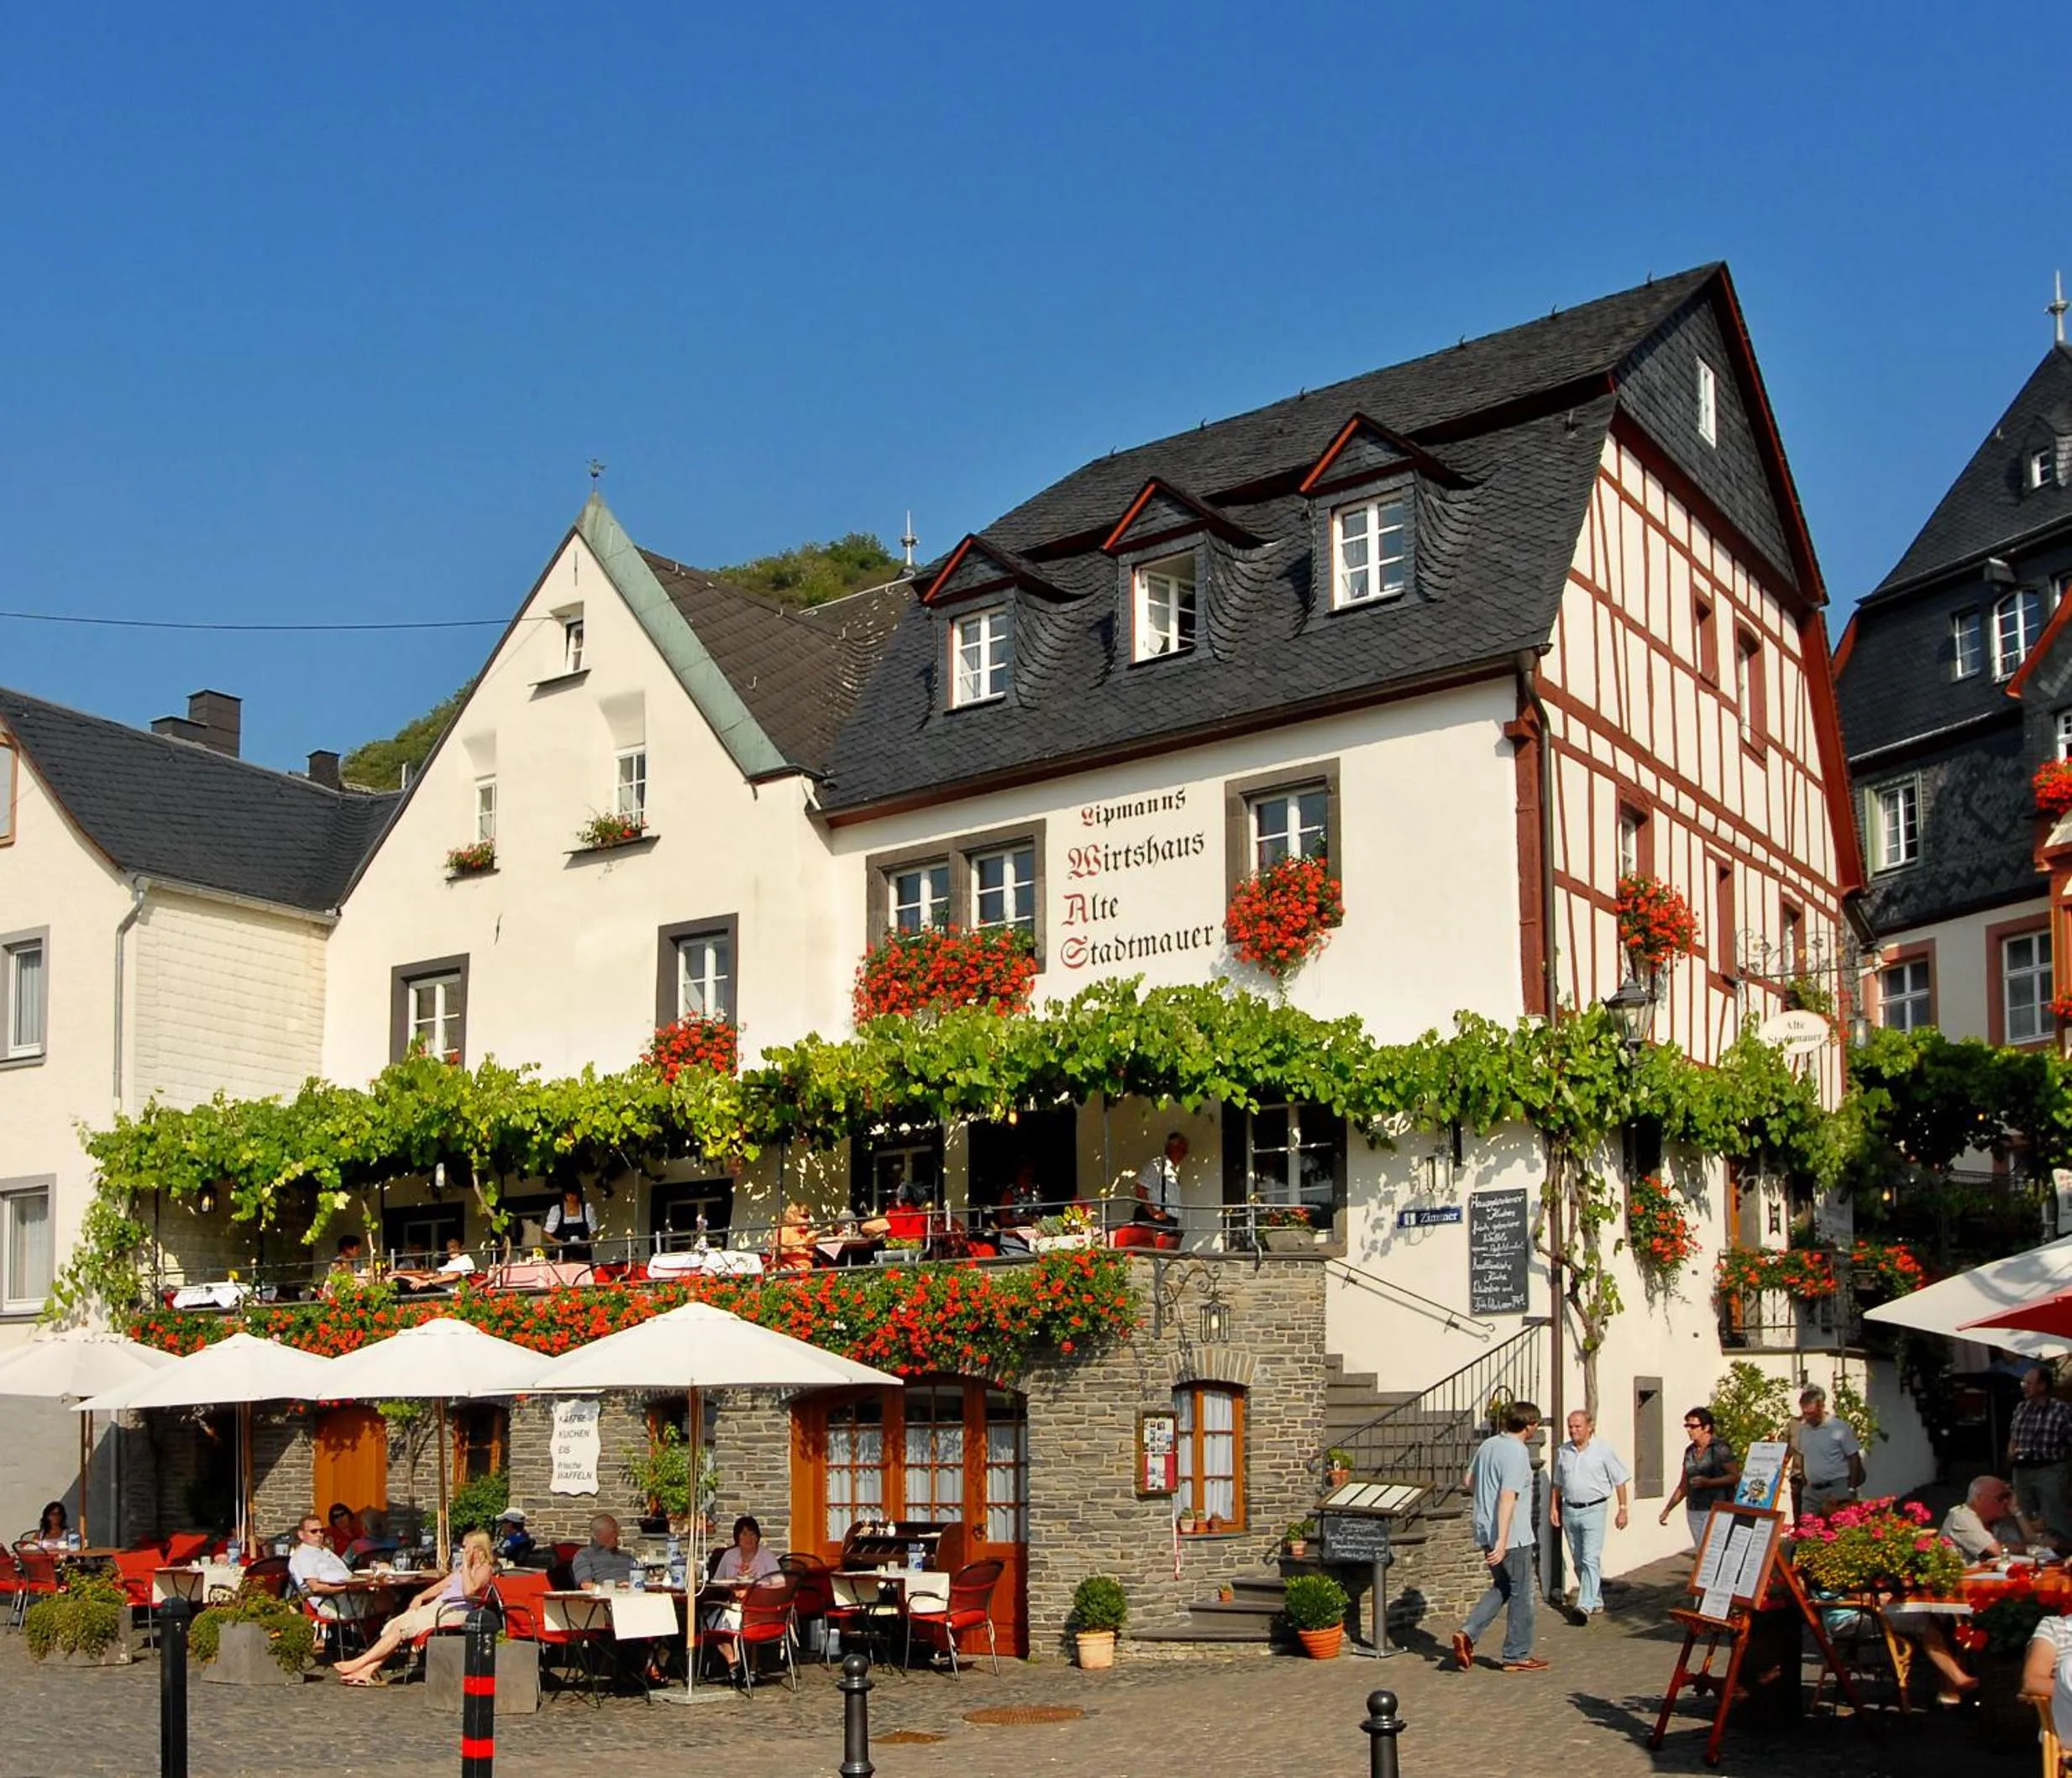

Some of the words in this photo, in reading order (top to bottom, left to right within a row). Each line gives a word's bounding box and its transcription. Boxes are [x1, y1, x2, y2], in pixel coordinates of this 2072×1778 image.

[1081, 787, 1186, 827] Lipmanns
[1067, 830, 1204, 880] Wirtshaus
[1061, 892, 1119, 926] Alte
[1060, 924, 1214, 969] Stadtmauer
[1767, 1033, 1821, 1044] Stamauer
